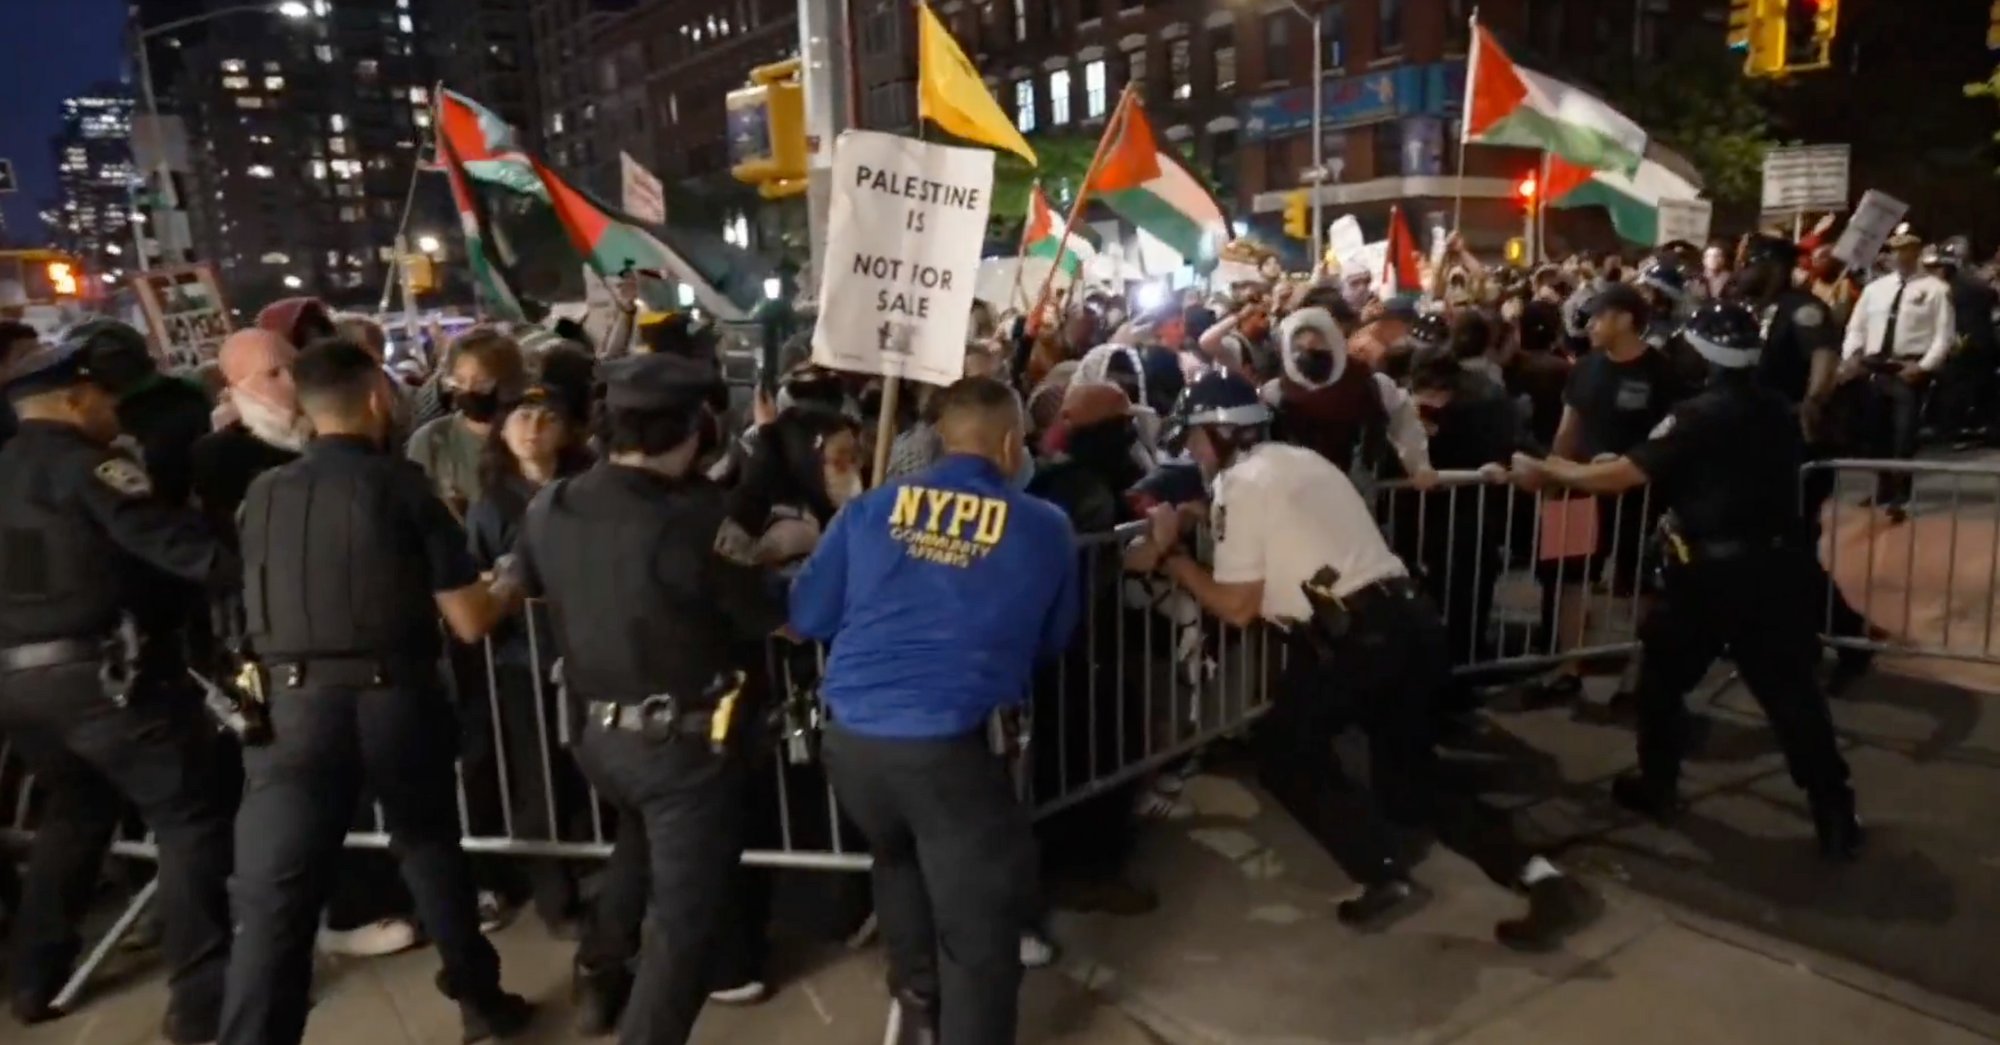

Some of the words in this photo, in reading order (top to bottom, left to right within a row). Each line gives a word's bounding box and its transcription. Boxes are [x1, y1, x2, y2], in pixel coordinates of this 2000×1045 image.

[856, 165, 980, 210] PALESTINE
[906, 210, 925, 232] IS
[853, 253, 903, 281] NOT
[876, 290, 930, 319] SALE
[888, 485, 1008, 545] NYPD
